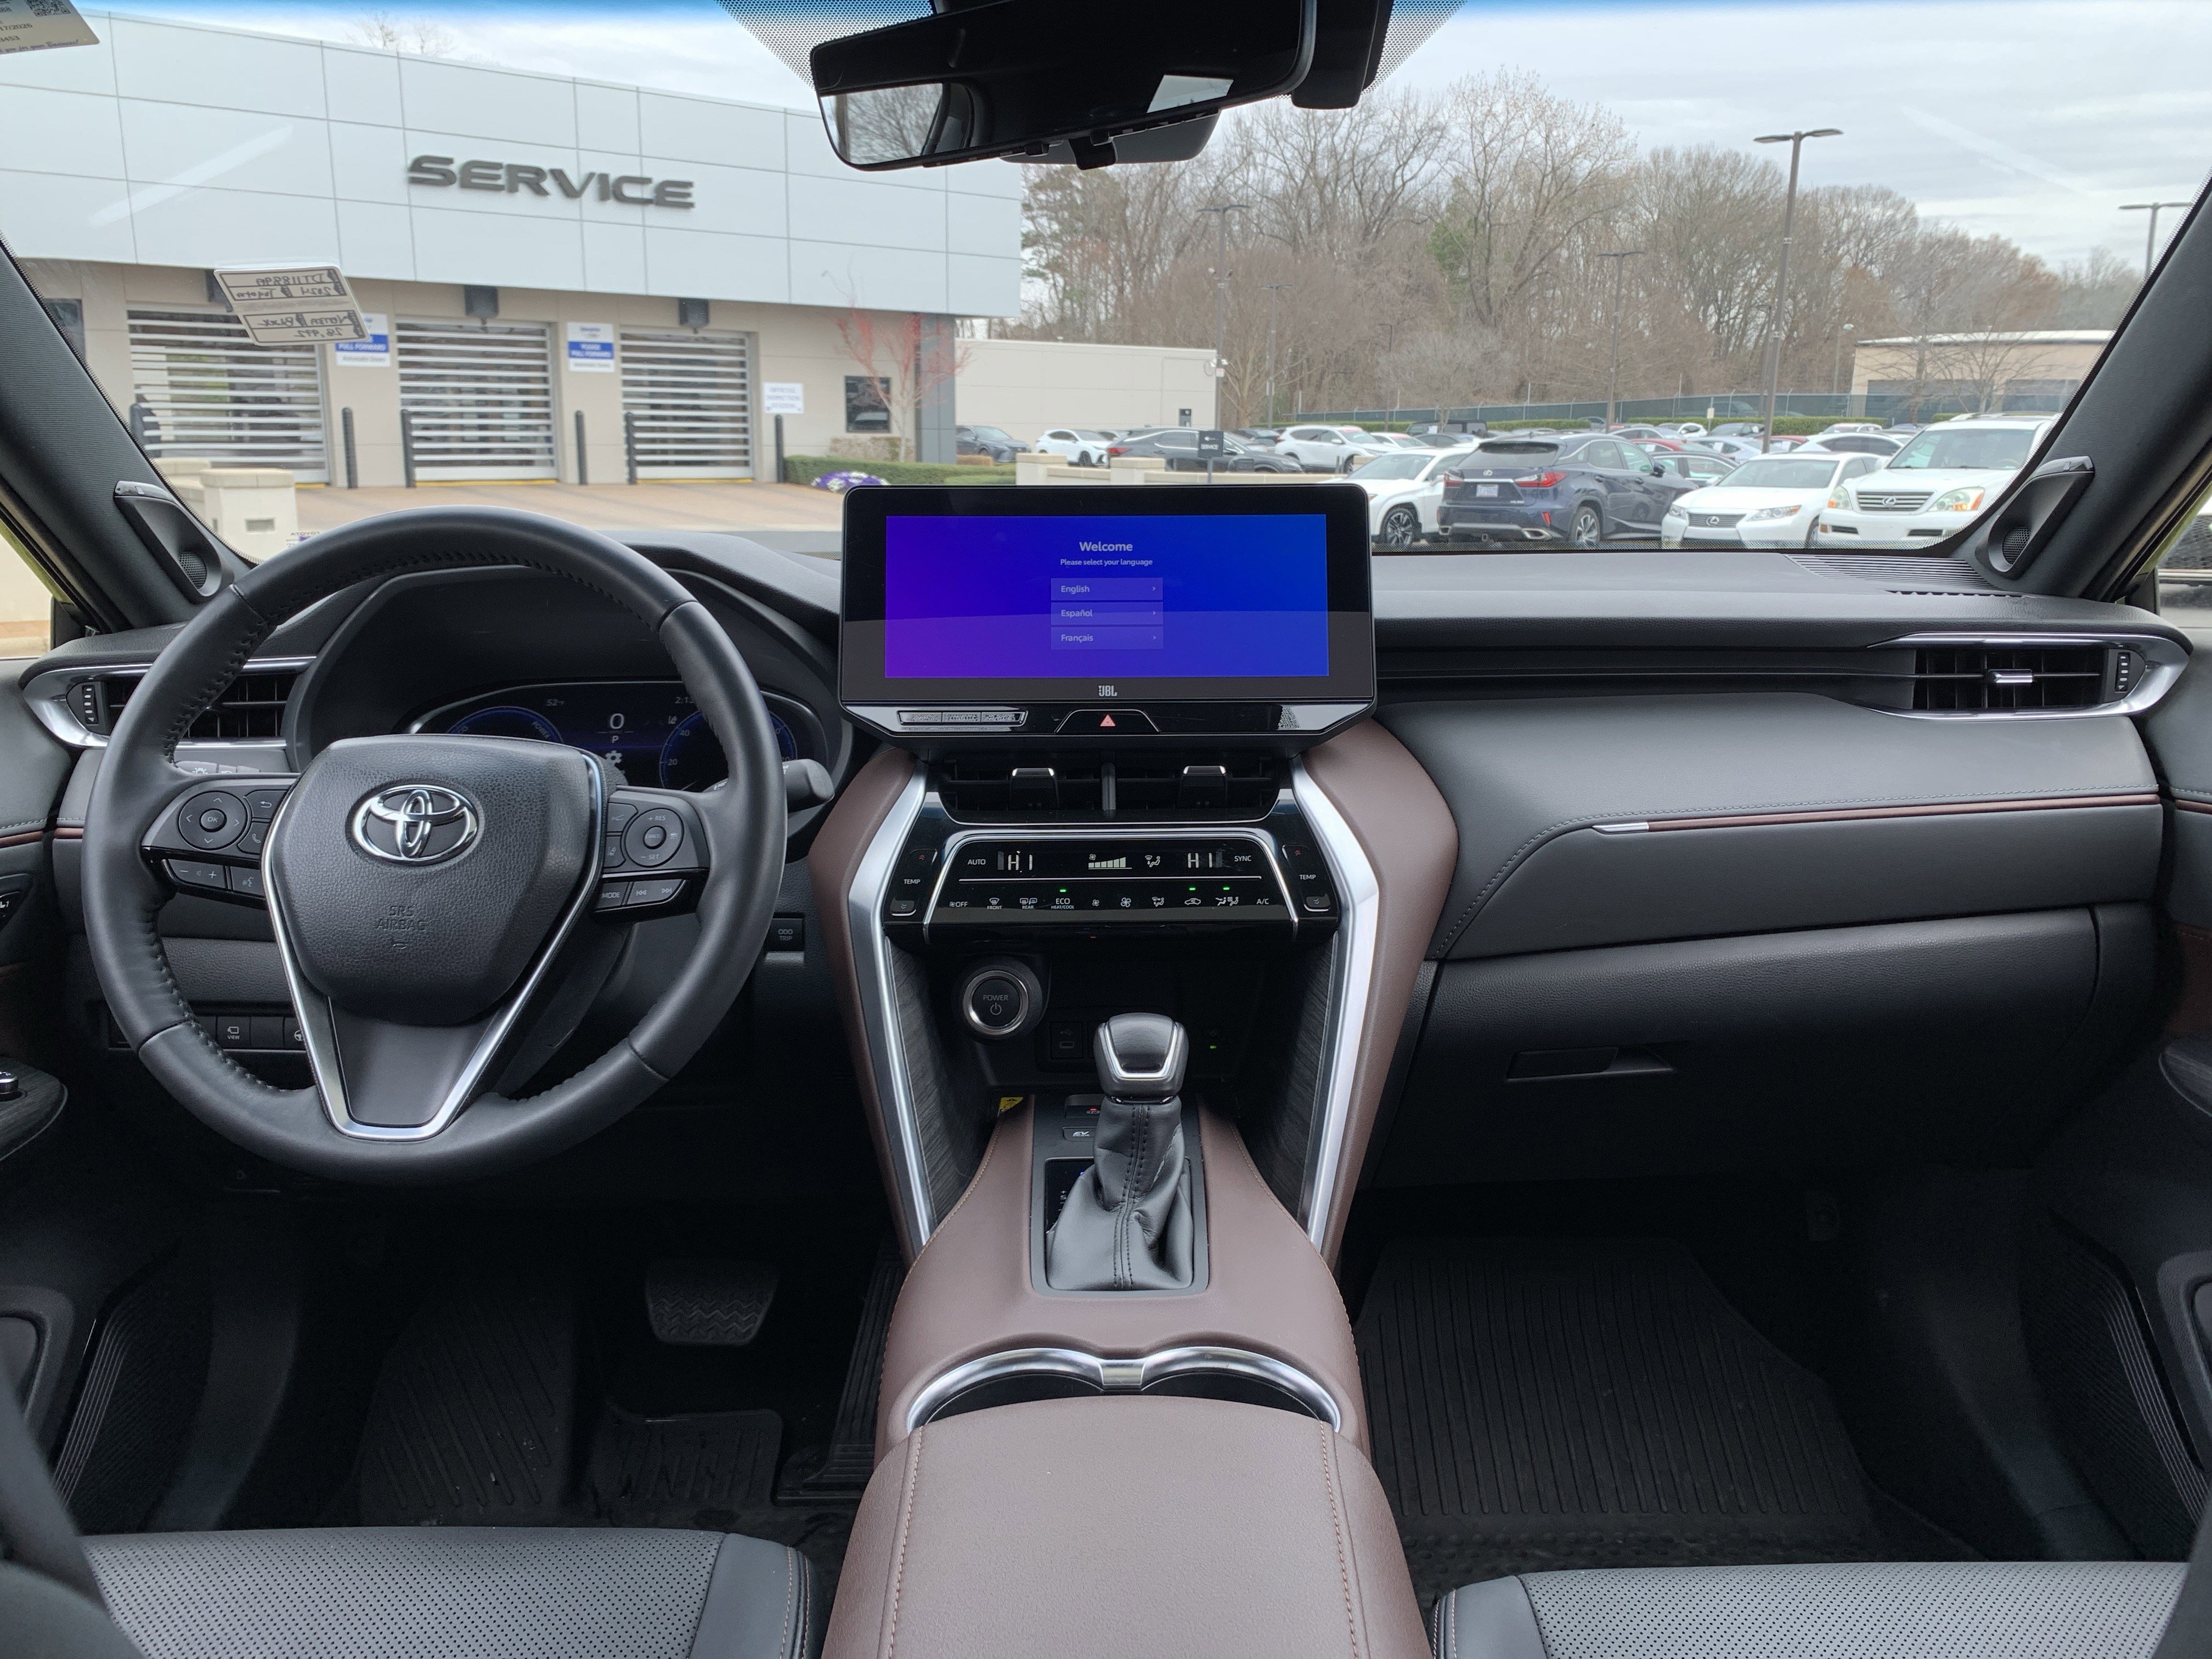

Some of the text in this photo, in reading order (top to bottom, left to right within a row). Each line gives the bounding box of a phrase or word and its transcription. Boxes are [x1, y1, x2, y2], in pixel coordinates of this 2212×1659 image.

[407, 154, 695, 209] SERVICE
[1079, 541, 1133, 551] Welcome
[1120, 558, 1153, 567] language
[1060, 585, 1090, 594] English
[1060, 609, 1093, 618] Español
[1060, 634, 1093, 643] Français
[1098, 685, 1118, 697] JBL
[609, 713, 625, 730] 0
[612, 735, 619, 743] P
[372, 918, 428, 932] AIRBAG
